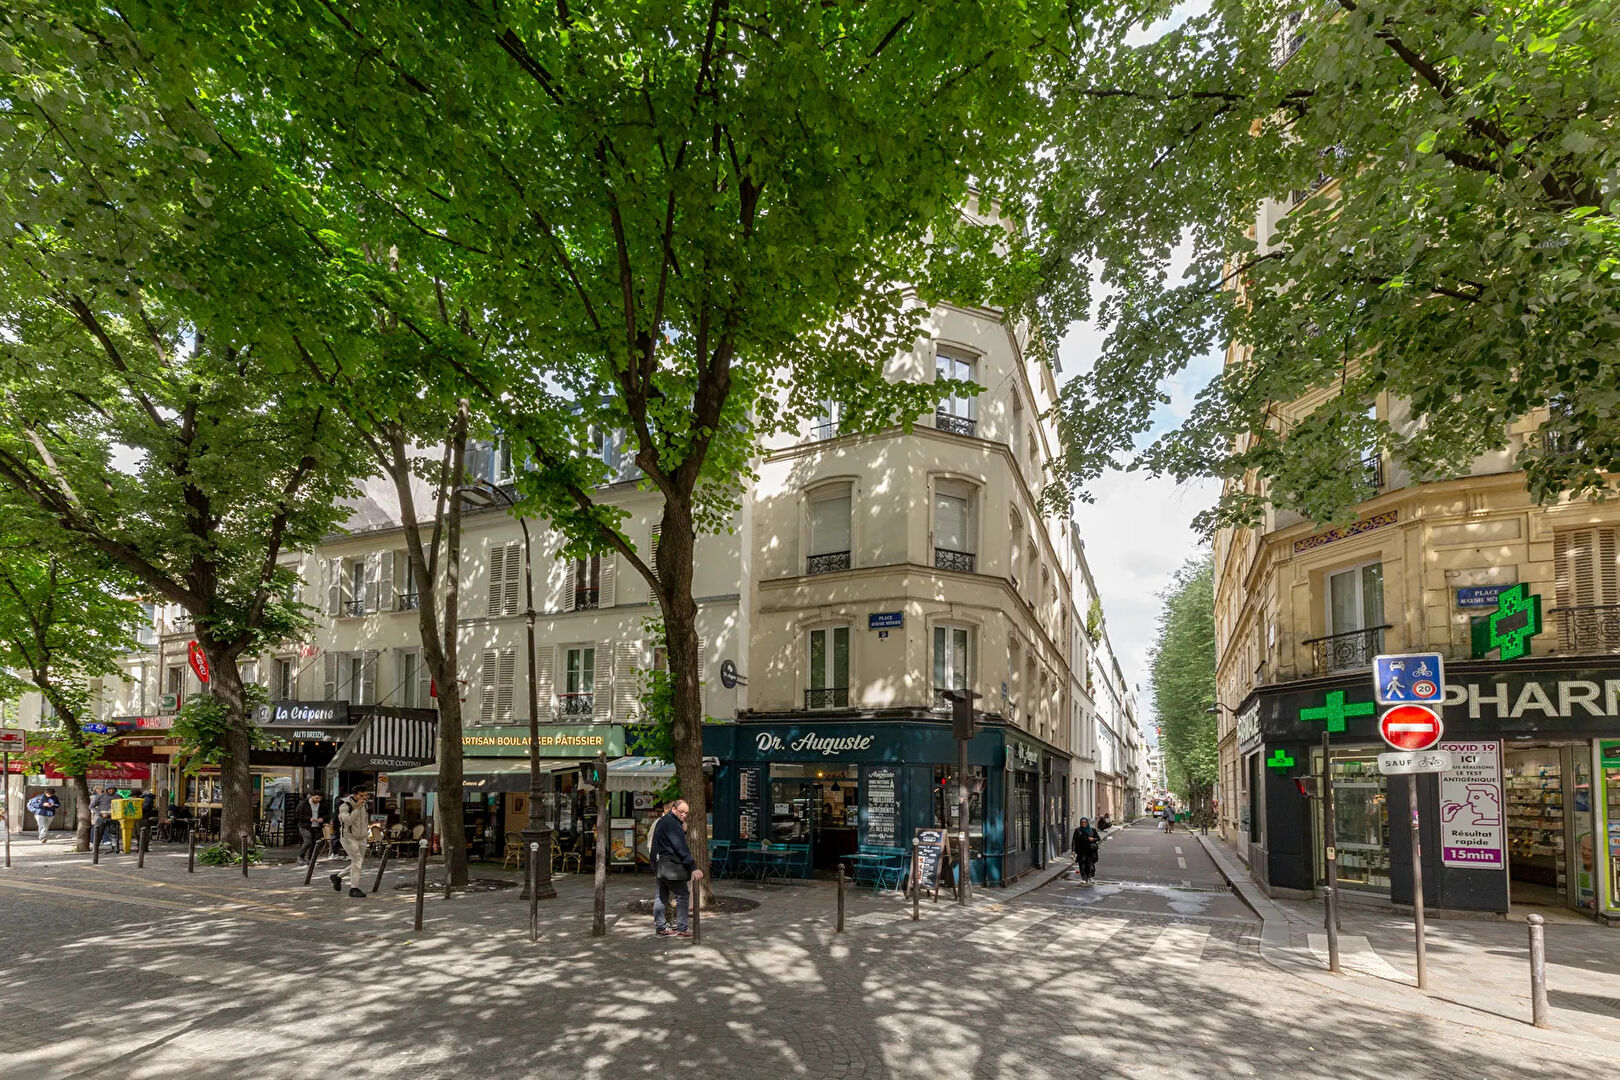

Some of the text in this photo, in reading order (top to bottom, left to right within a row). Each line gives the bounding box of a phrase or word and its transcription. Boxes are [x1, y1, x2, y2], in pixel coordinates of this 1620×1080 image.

[275, 706, 288, 720] La
[291, 705, 334, 722] Crêperie
[136, 717, 161, 728] TABAC
[461, 736, 495, 745] ARTISAN
[556, 734, 602, 745] PÂTISSIER
[756, 732, 871, 755] Dr. Auguste
[1451, 850, 1494, 860] 15min
